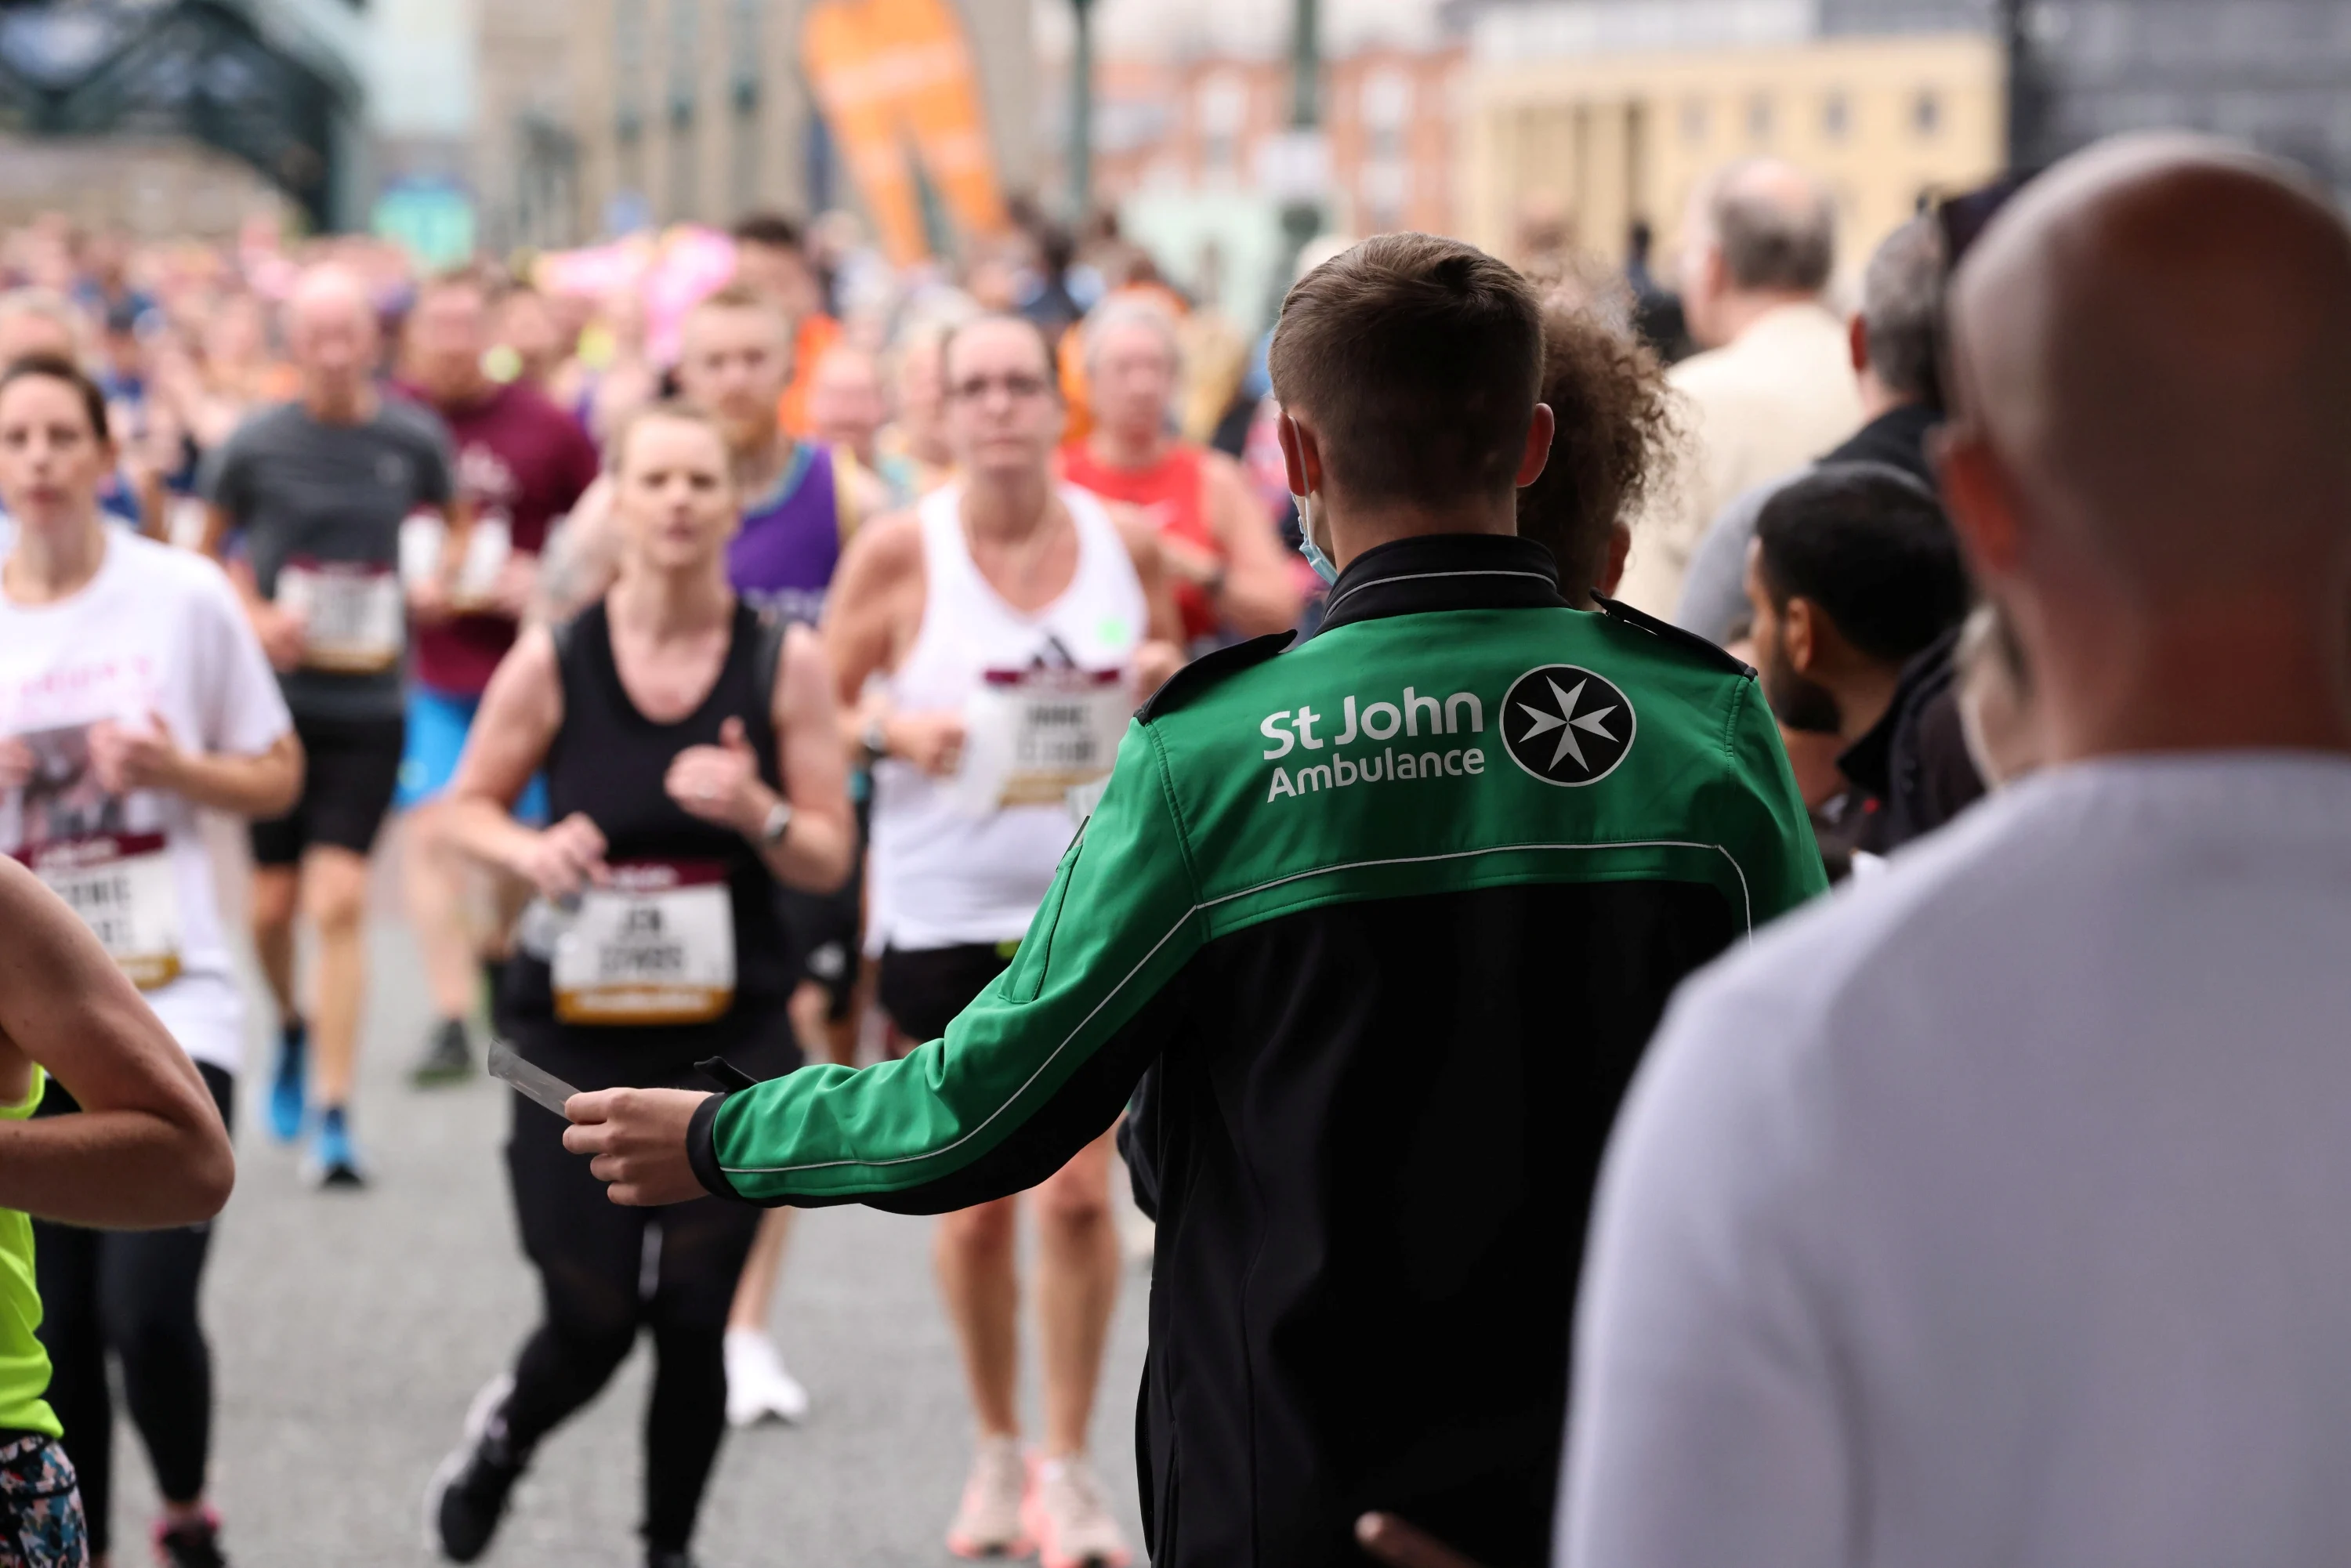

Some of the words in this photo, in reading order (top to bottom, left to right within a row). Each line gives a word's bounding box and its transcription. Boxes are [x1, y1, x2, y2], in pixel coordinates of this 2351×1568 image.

[1259, 705, 1324, 761] St
[1334, 686, 1483, 746] John
[1266, 747, 1485, 803] Ambulance
